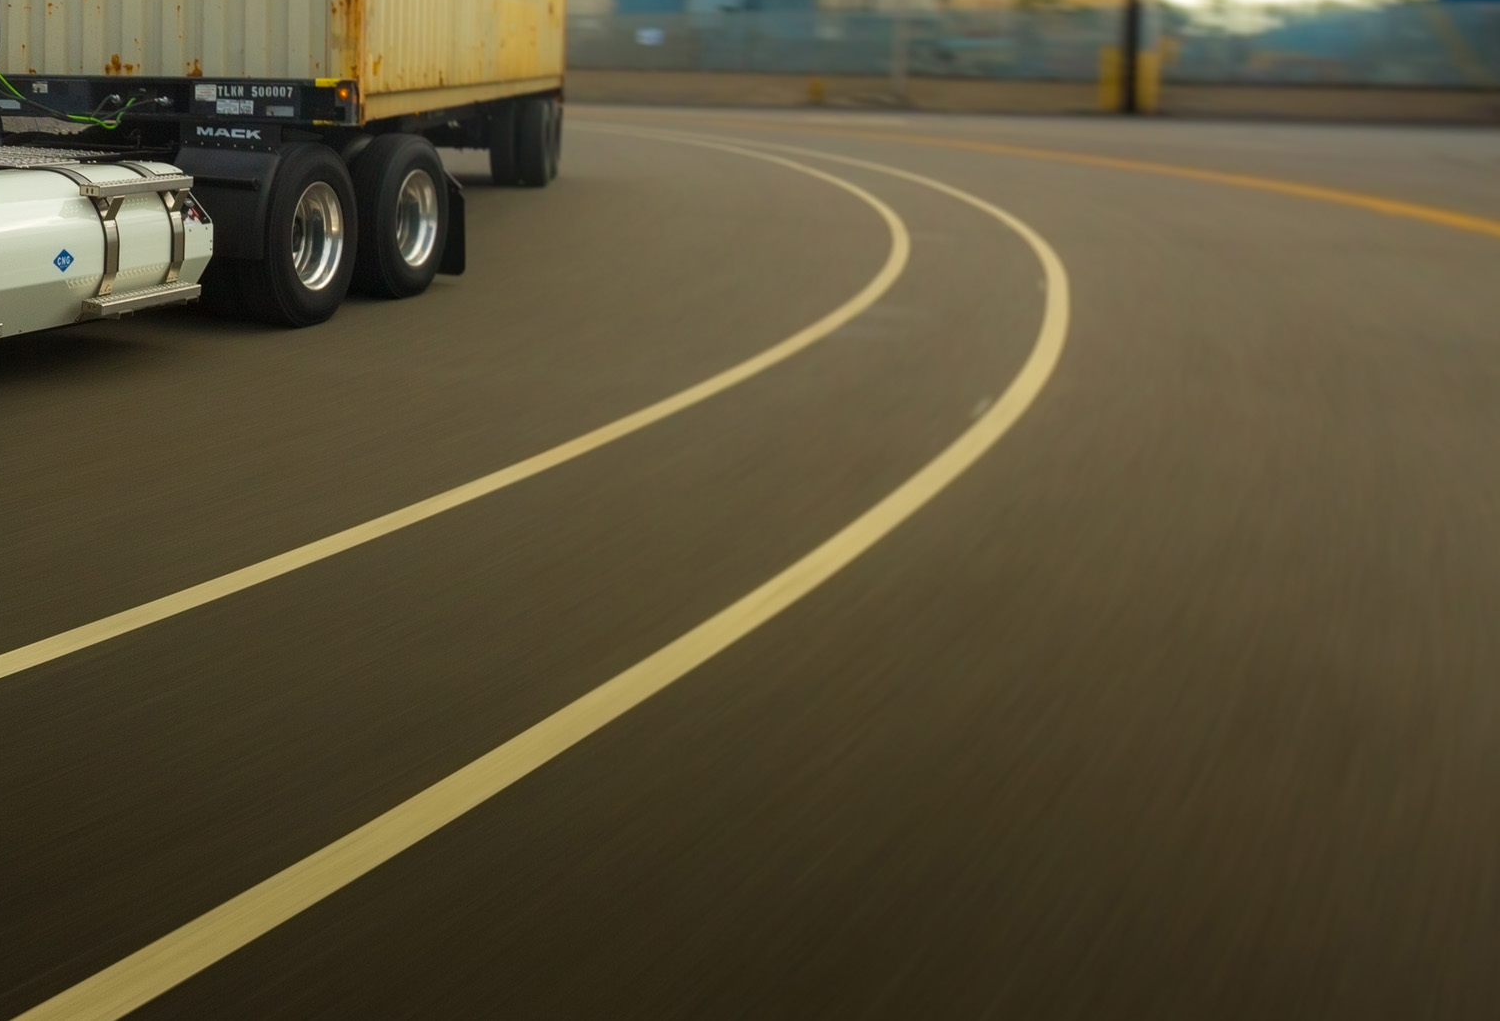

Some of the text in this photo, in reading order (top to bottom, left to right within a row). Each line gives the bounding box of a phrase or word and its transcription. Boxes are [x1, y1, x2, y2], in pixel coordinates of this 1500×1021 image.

[251, 86, 293, 98] 500007
[196, 126, 261, 140] MACK
[56, 255, 71, 266] CNG
